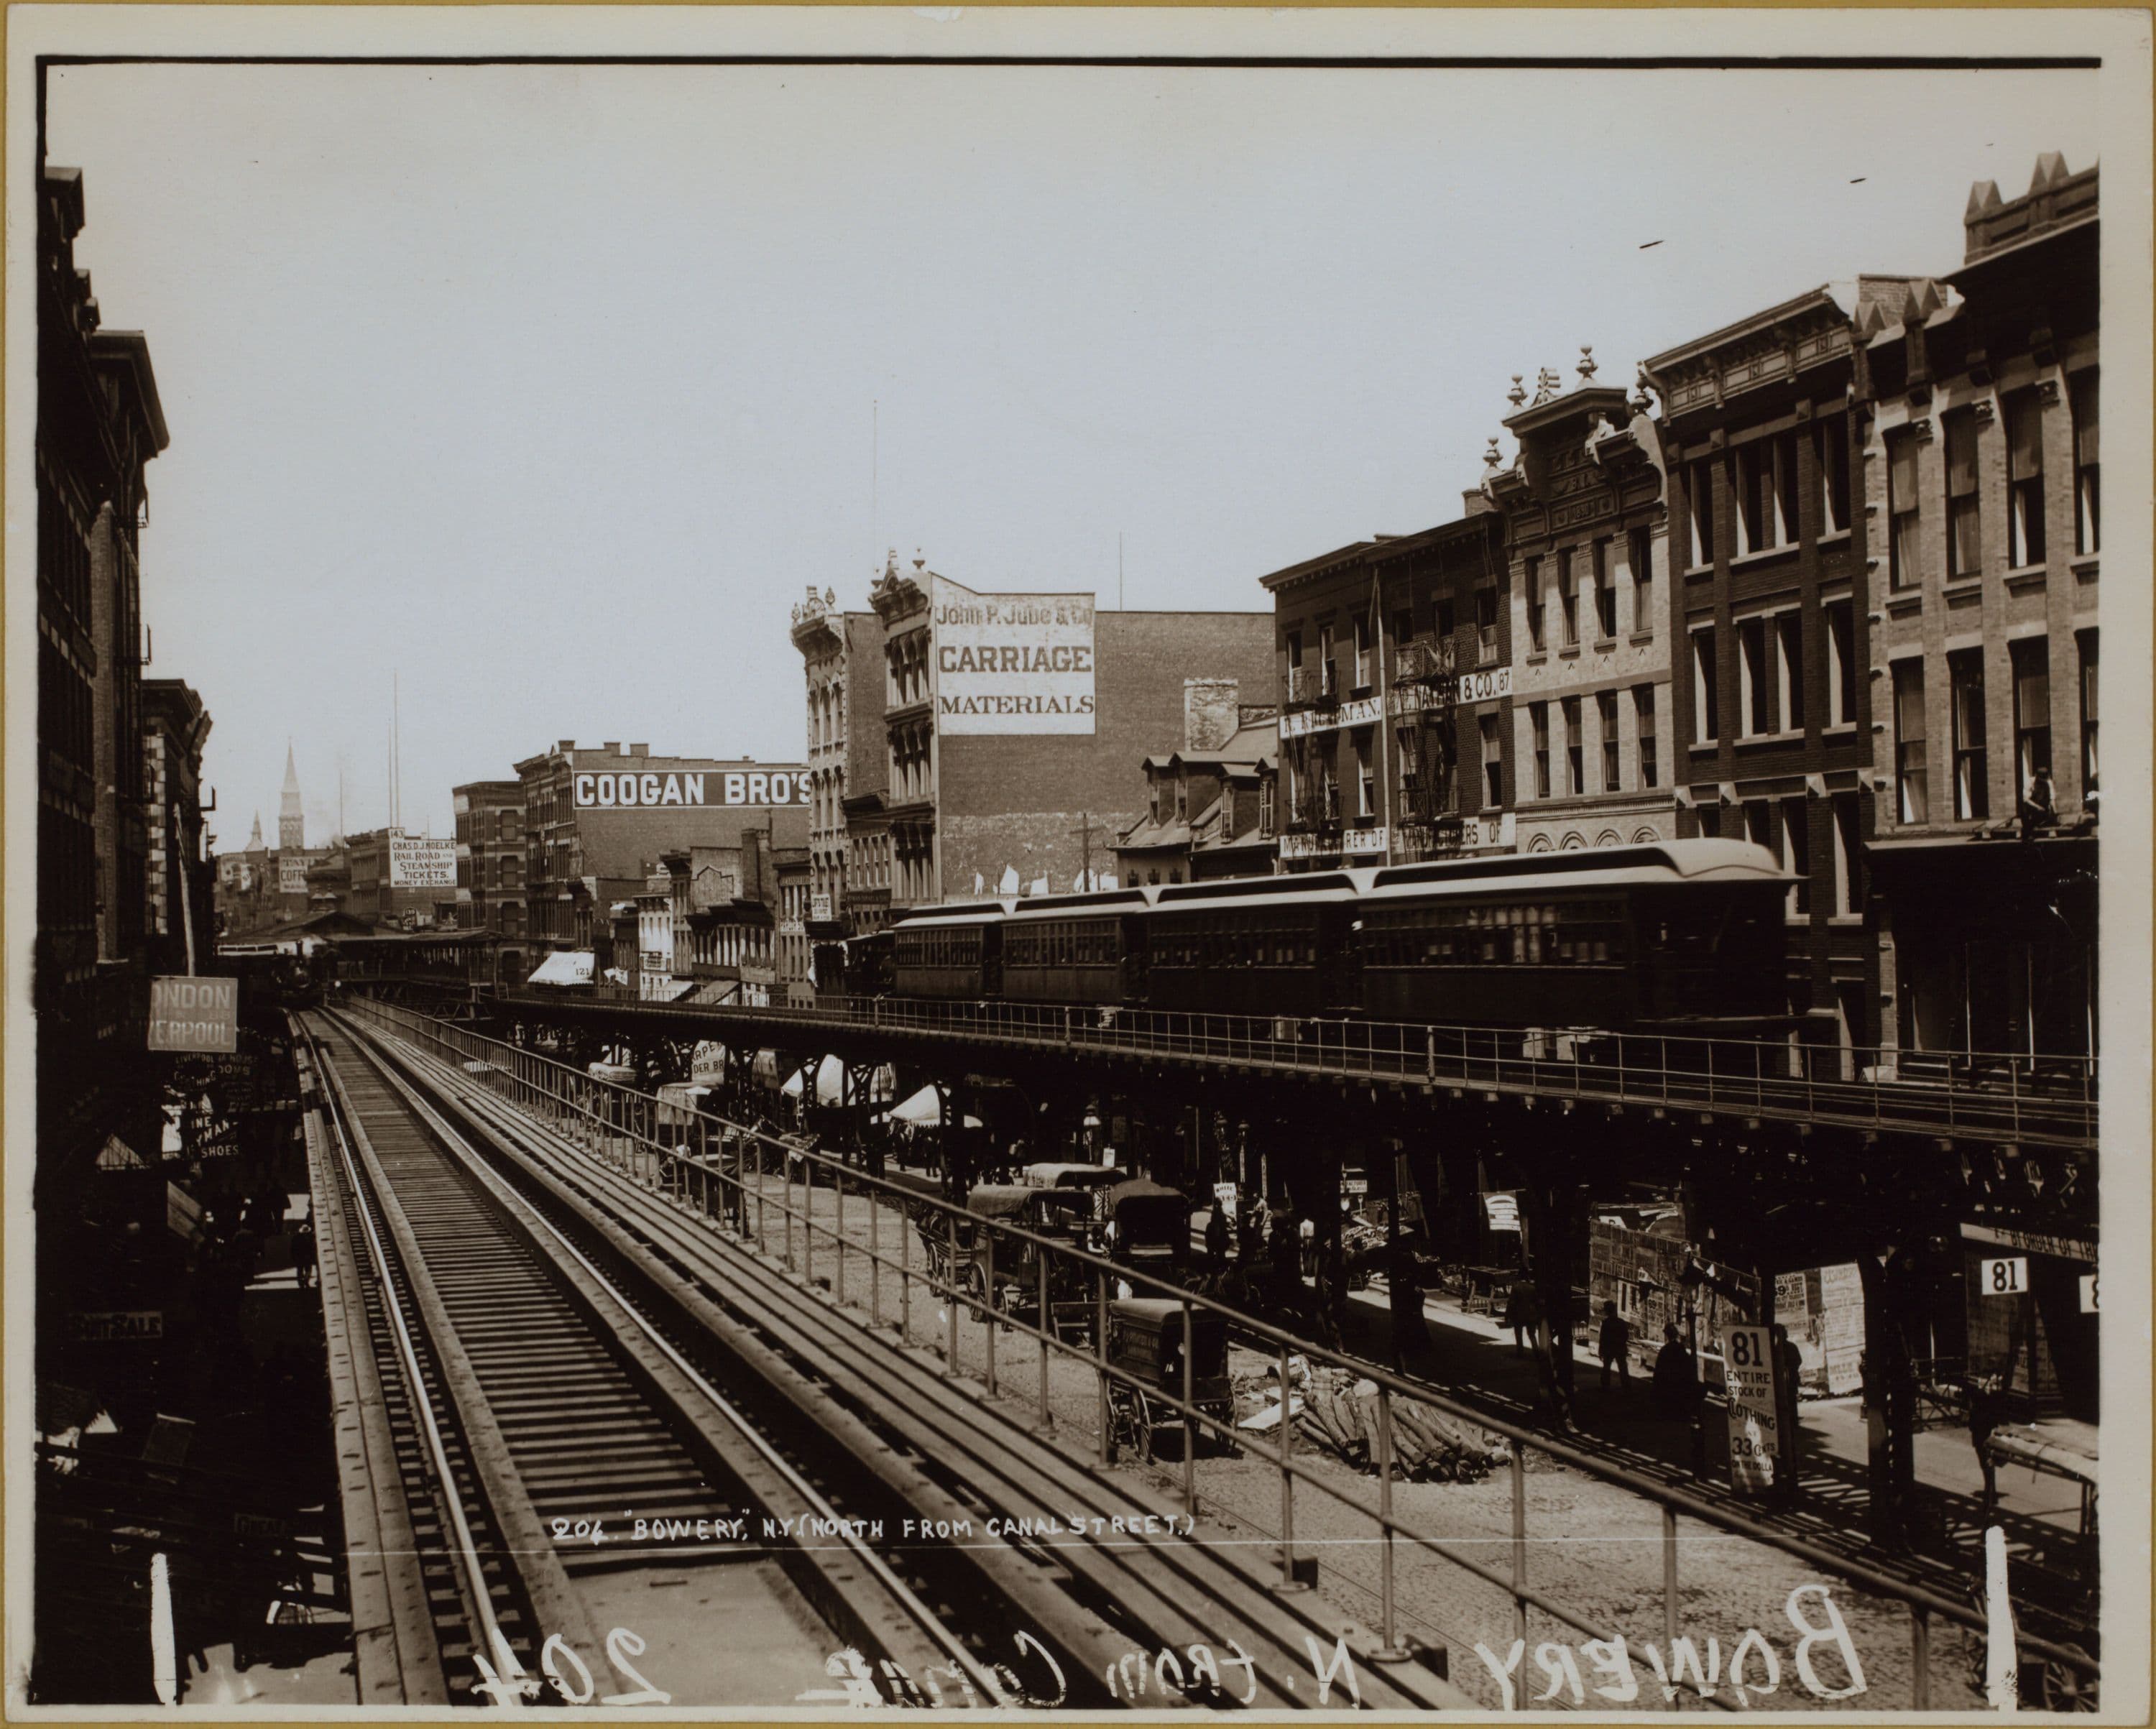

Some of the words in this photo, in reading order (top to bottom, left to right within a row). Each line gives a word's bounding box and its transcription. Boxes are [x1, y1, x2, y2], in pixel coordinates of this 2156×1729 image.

[937, 604, 980, 625] John
[939, 646, 1092, 673] CARRIAGE
[1464, 676, 1473, 701] &
[1475, 672, 1497, 698] CO.
[939, 695, 1094, 714] MATERIALS
[576, 773, 704, 806] COOGAN
[724, 773, 810, 805] BRO'S
[390, 829, 404, 839] 143
[1284, 831, 1366, 852] MANURER
[1372, 829, 1383, 847] OF
[1488, 821, 1502, 843] OF
[395, 852, 414, 861] RAIL
[415, 852, 441, 861] ROAD
[201, 1144, 239, 1159] SHOES
[1993, 1260, 2017, 1292] 81
[1731, 1331, 1763, 1367] 81
[1727, 1370, 1771, 1384] ENTIRE
[1728, 1385, 1755, 1398] STOCK
[1756, 1388, 1766, 1398] OF
[1728, 1398, 1775, 1431] CLOTHING
[1732, 1437, 1752, 1457] 33
